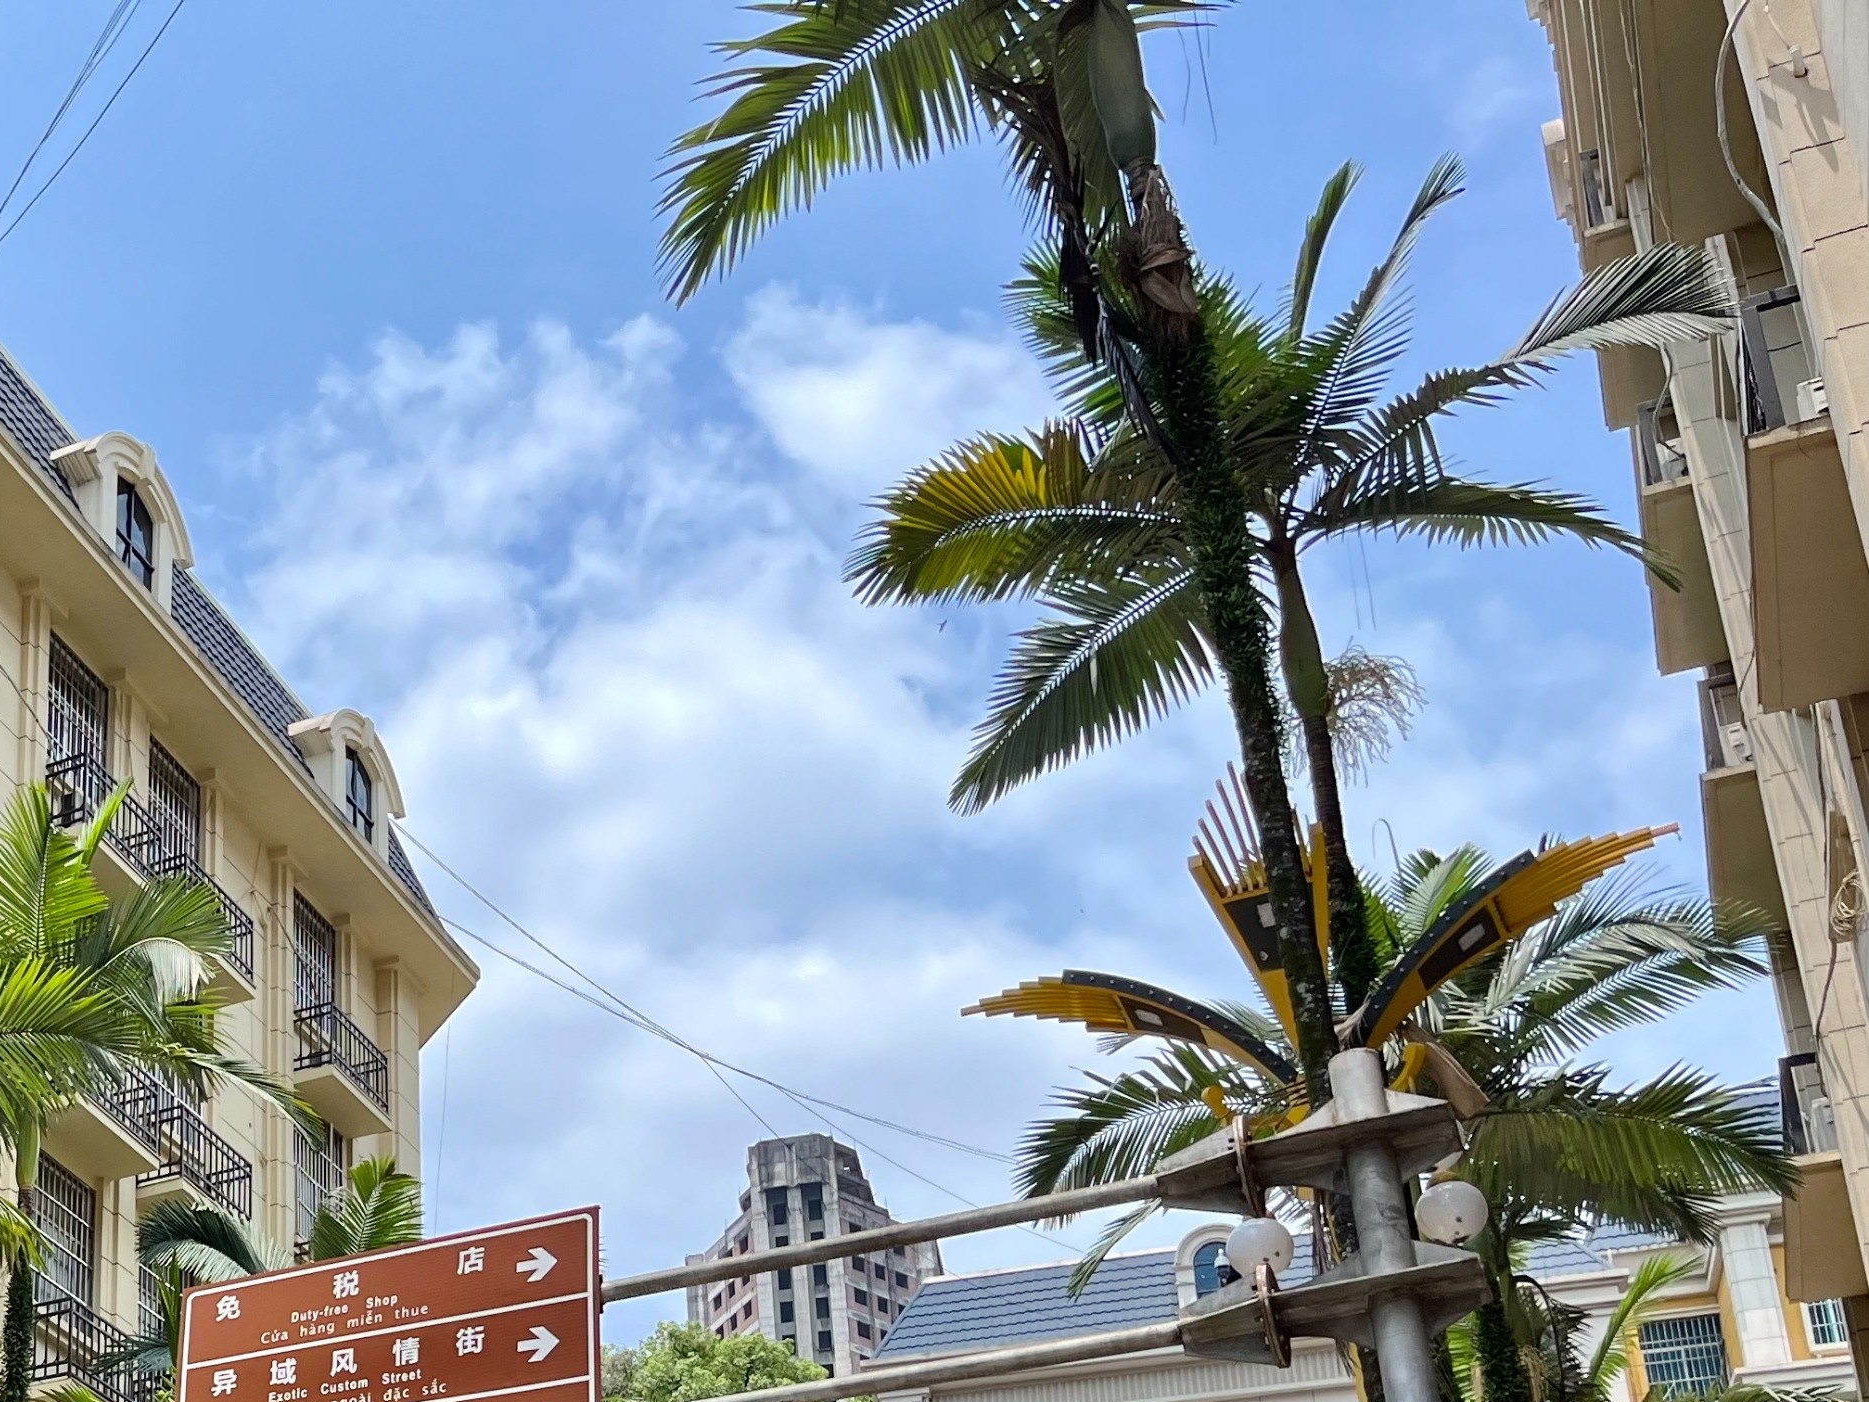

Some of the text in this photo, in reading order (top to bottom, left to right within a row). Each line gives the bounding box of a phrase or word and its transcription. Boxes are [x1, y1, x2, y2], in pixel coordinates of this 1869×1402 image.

[215, 1246, 485, 1322] 免税店
[290, 1295, 398, 1323] Duty-free Shop
[299, 1319, 336, 1338] hàng
[210, 1325, 485, 1398] 异域风情街
[320, 1378, 369, 1396] Custom
[381, 1368, 422, 1386] Street
